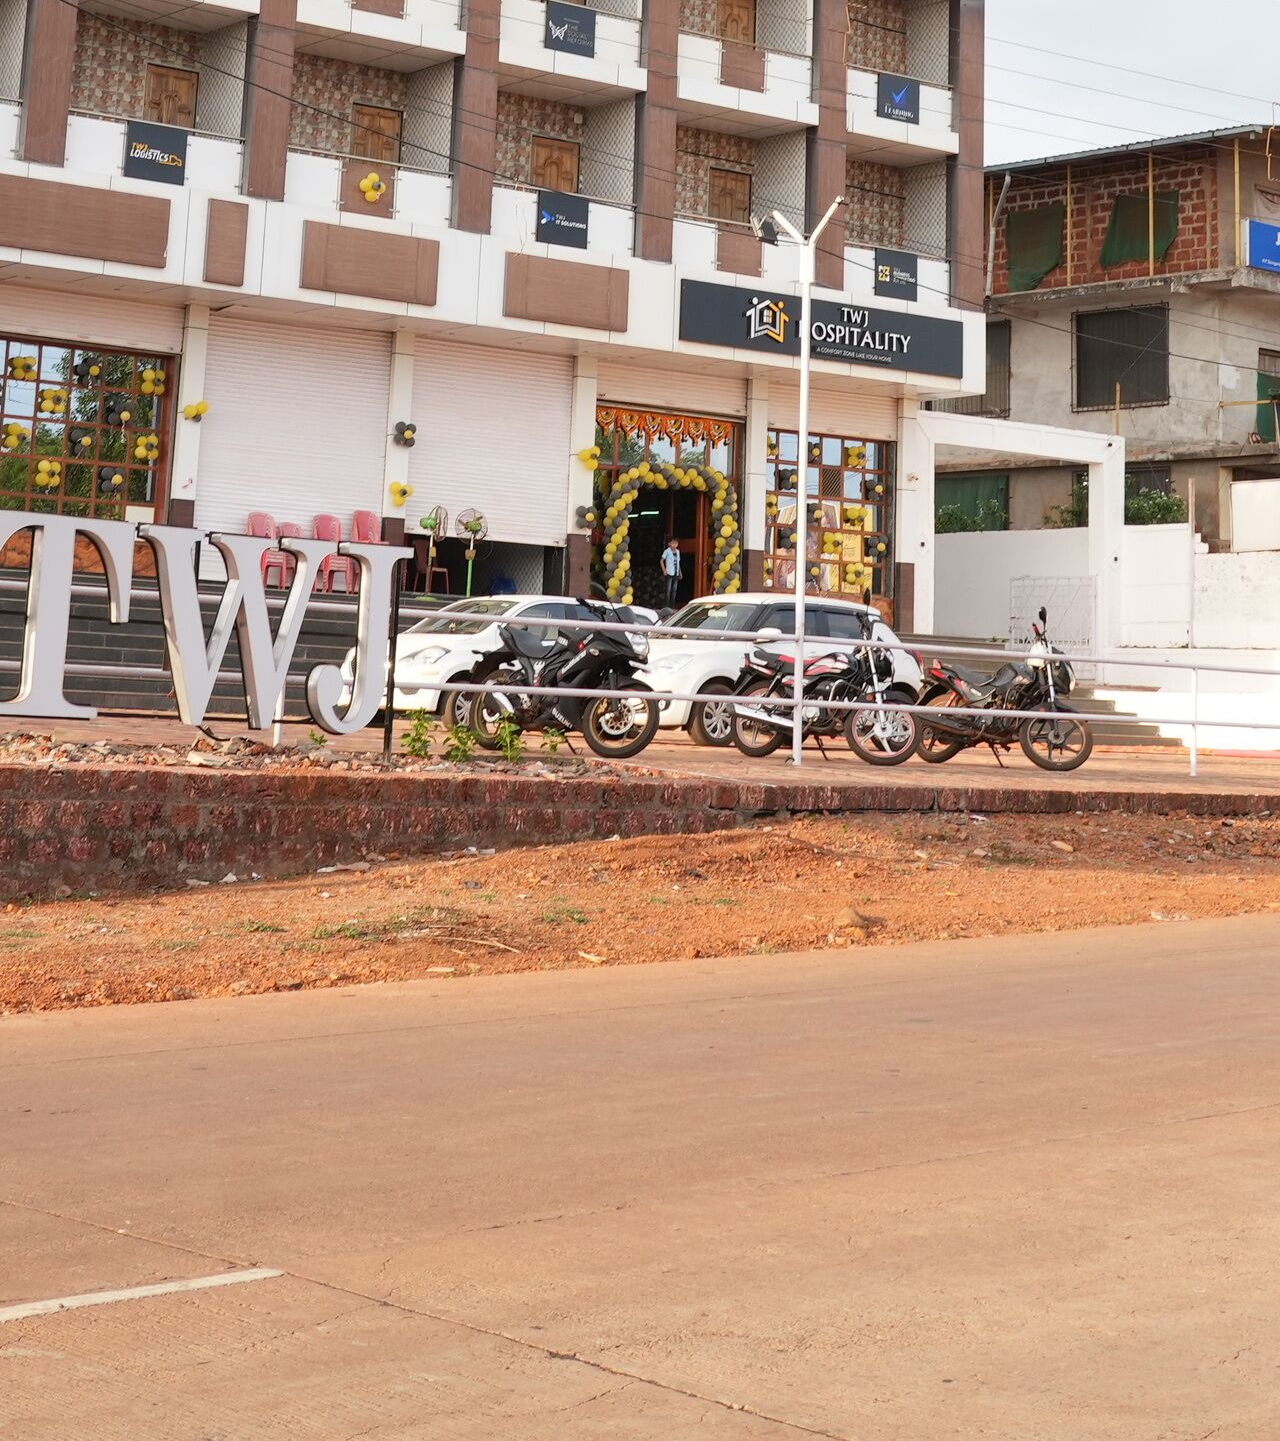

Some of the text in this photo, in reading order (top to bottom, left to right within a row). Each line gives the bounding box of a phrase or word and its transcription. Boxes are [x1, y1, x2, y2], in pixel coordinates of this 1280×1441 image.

[129, 149, 170, 162] LOGISTICS
[131, 142, 149, 151] TWJ
[841, 307, 869, 327] TWJ
[799, 319, 911, 354] OSPITALITY
[551, 707, 573, 729] SUZUKI
